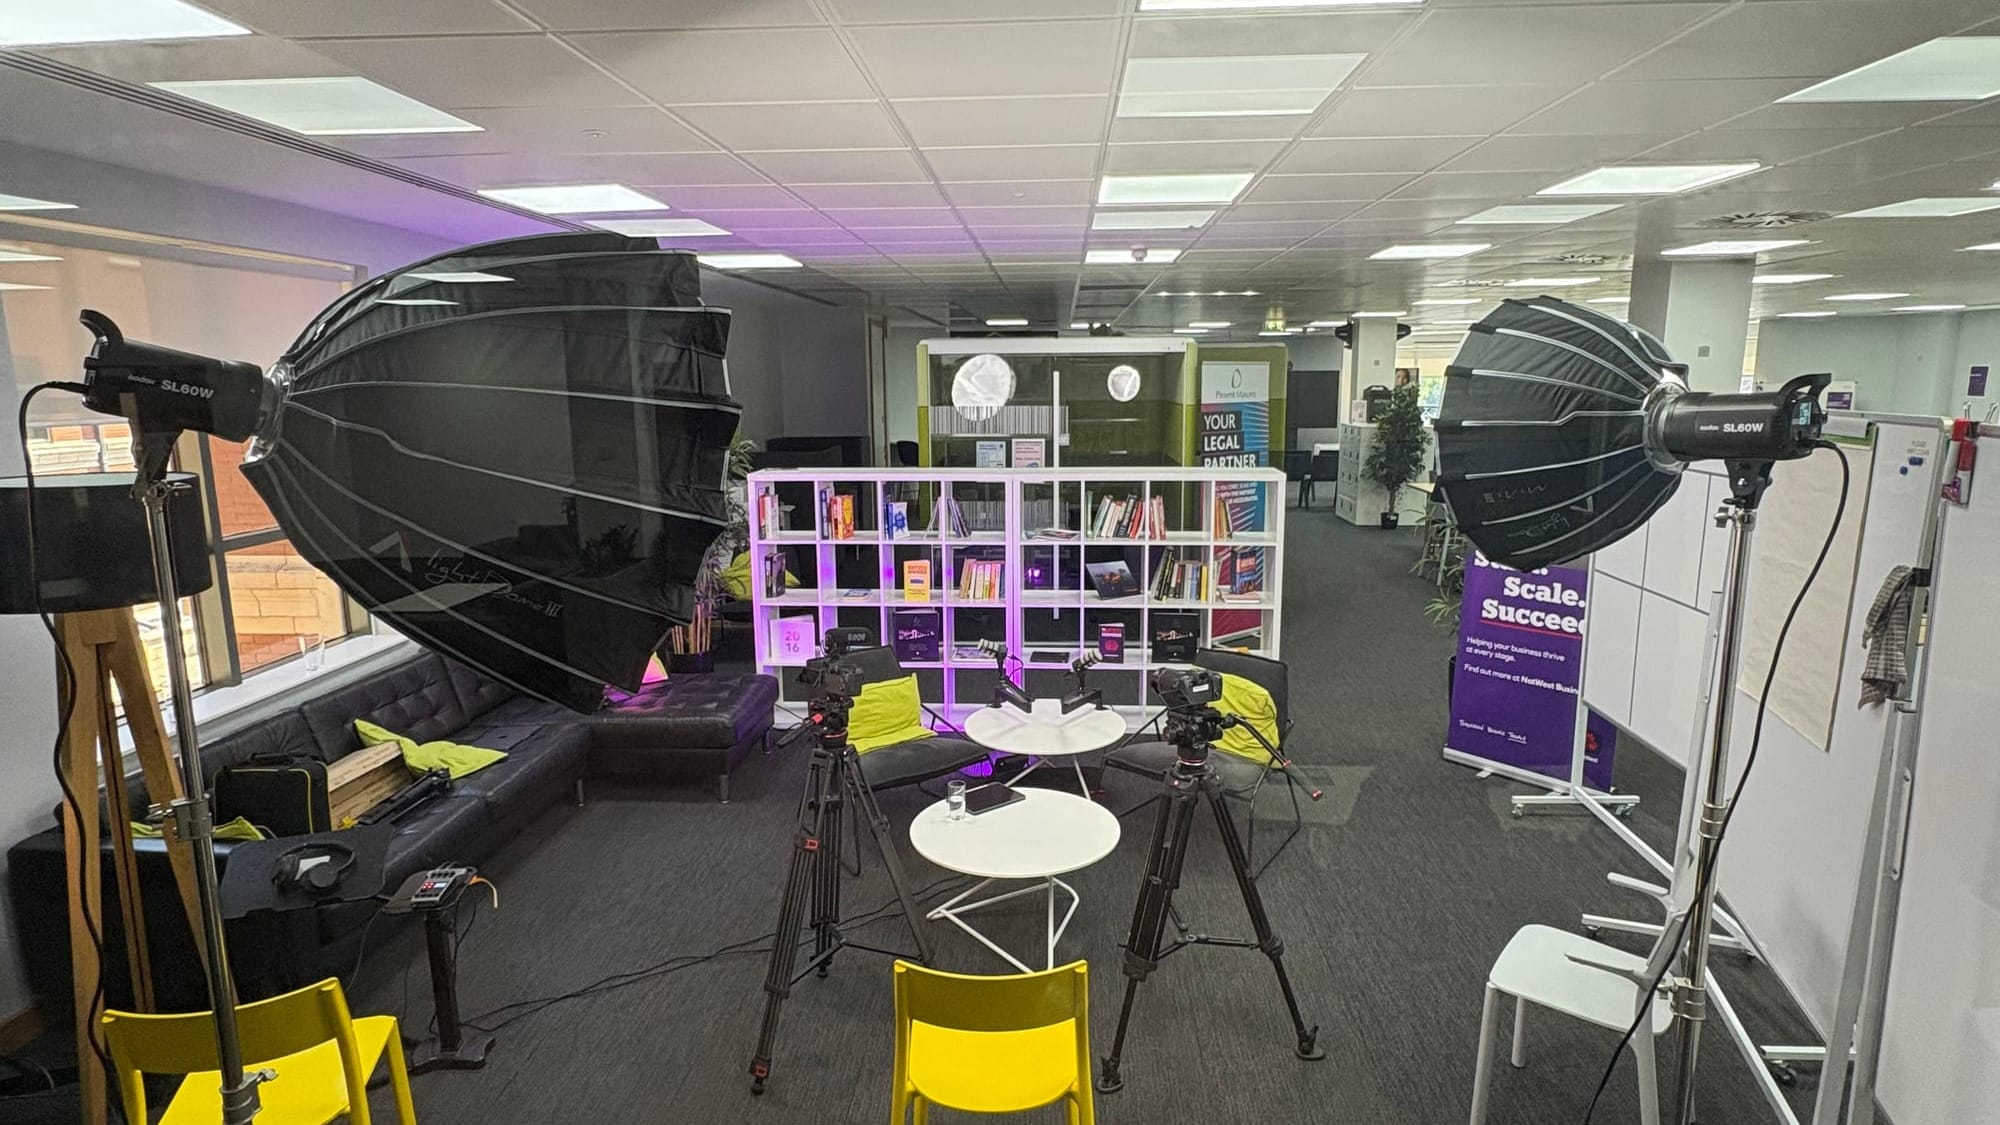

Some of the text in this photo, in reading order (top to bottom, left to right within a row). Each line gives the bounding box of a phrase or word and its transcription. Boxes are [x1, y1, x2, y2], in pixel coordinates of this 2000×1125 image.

[161, 379, 214, 398] SL60W
[1204, 414, 1236, 430] YOUR
[1723, 422, 1764, 433] SL60W
[1204, 434, 1240, 452] LEGAL
[1204, 453, 1257, 468] PARTNER
[1503, 576, 1586, 608] Scale.
[785, 631, 800, 641] 20
[786, 643, 800, 653] 16
[1466, 636, 1565, 661] Helping your business thrive
[1474, 648, 1494, 658] every
[1495, 652, 1516, 663] stage.
[1464, 663, 1479, 673] Find
[1480, 668, 1491, 676] out
[1492, 671, 1511, 680] more
[1512, 674, 1520, 682] at
[1521, 675, 1554, 690] NatWest
